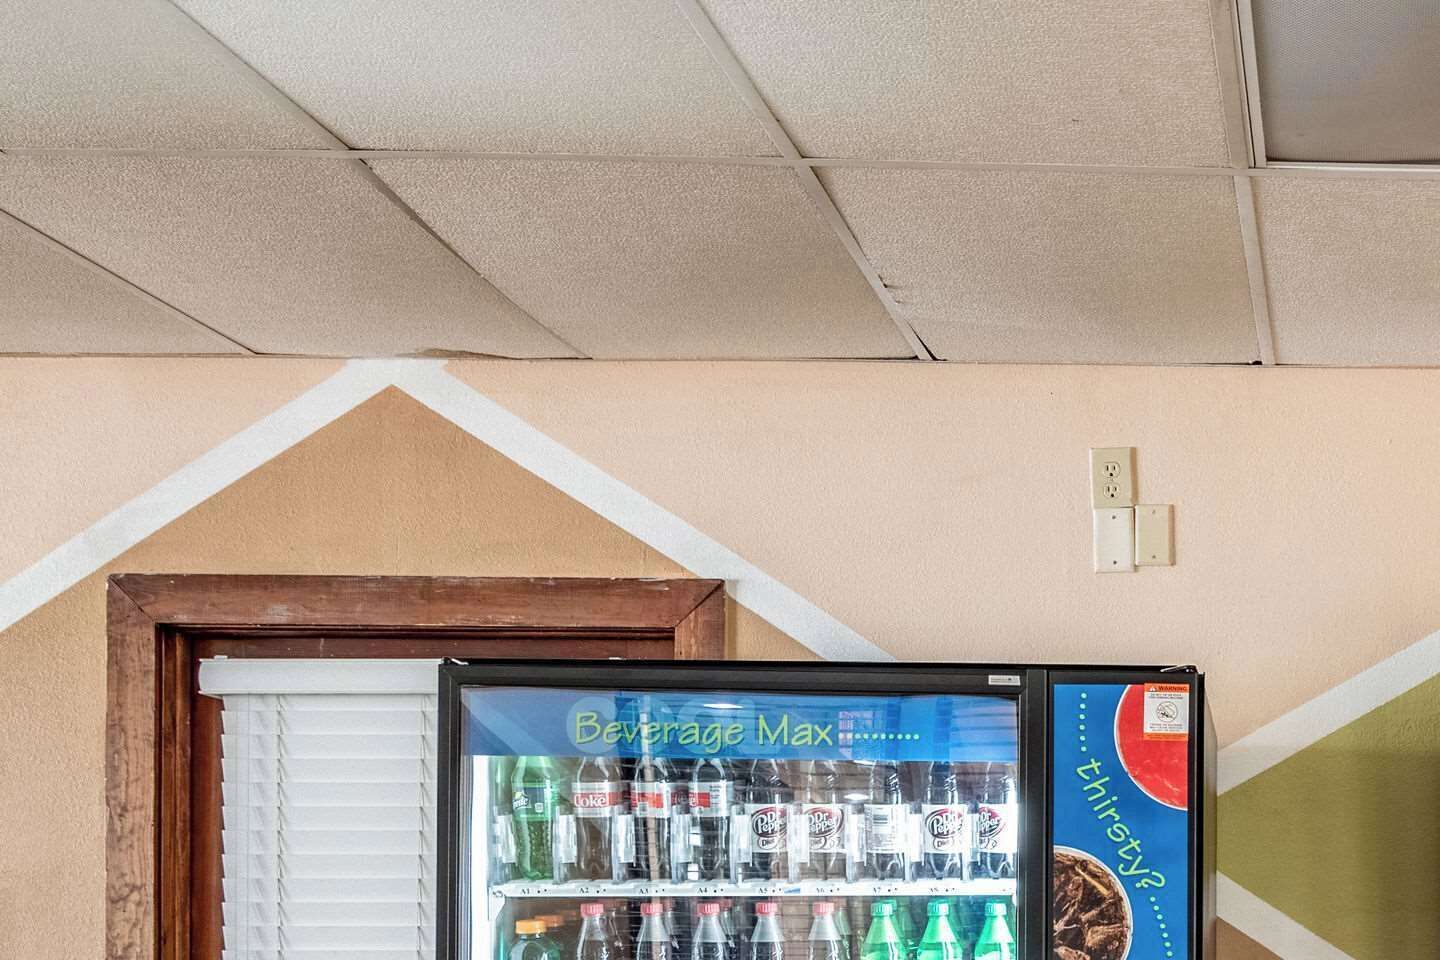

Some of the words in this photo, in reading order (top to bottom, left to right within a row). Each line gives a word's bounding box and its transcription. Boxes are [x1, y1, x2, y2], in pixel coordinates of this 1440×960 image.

[575, 711, 744, 753] Beverage
[758, 713, 833, 747] Max
[816, 811, 829, 822] Dr
[1076, 758, 1166, 889] thirsty?
